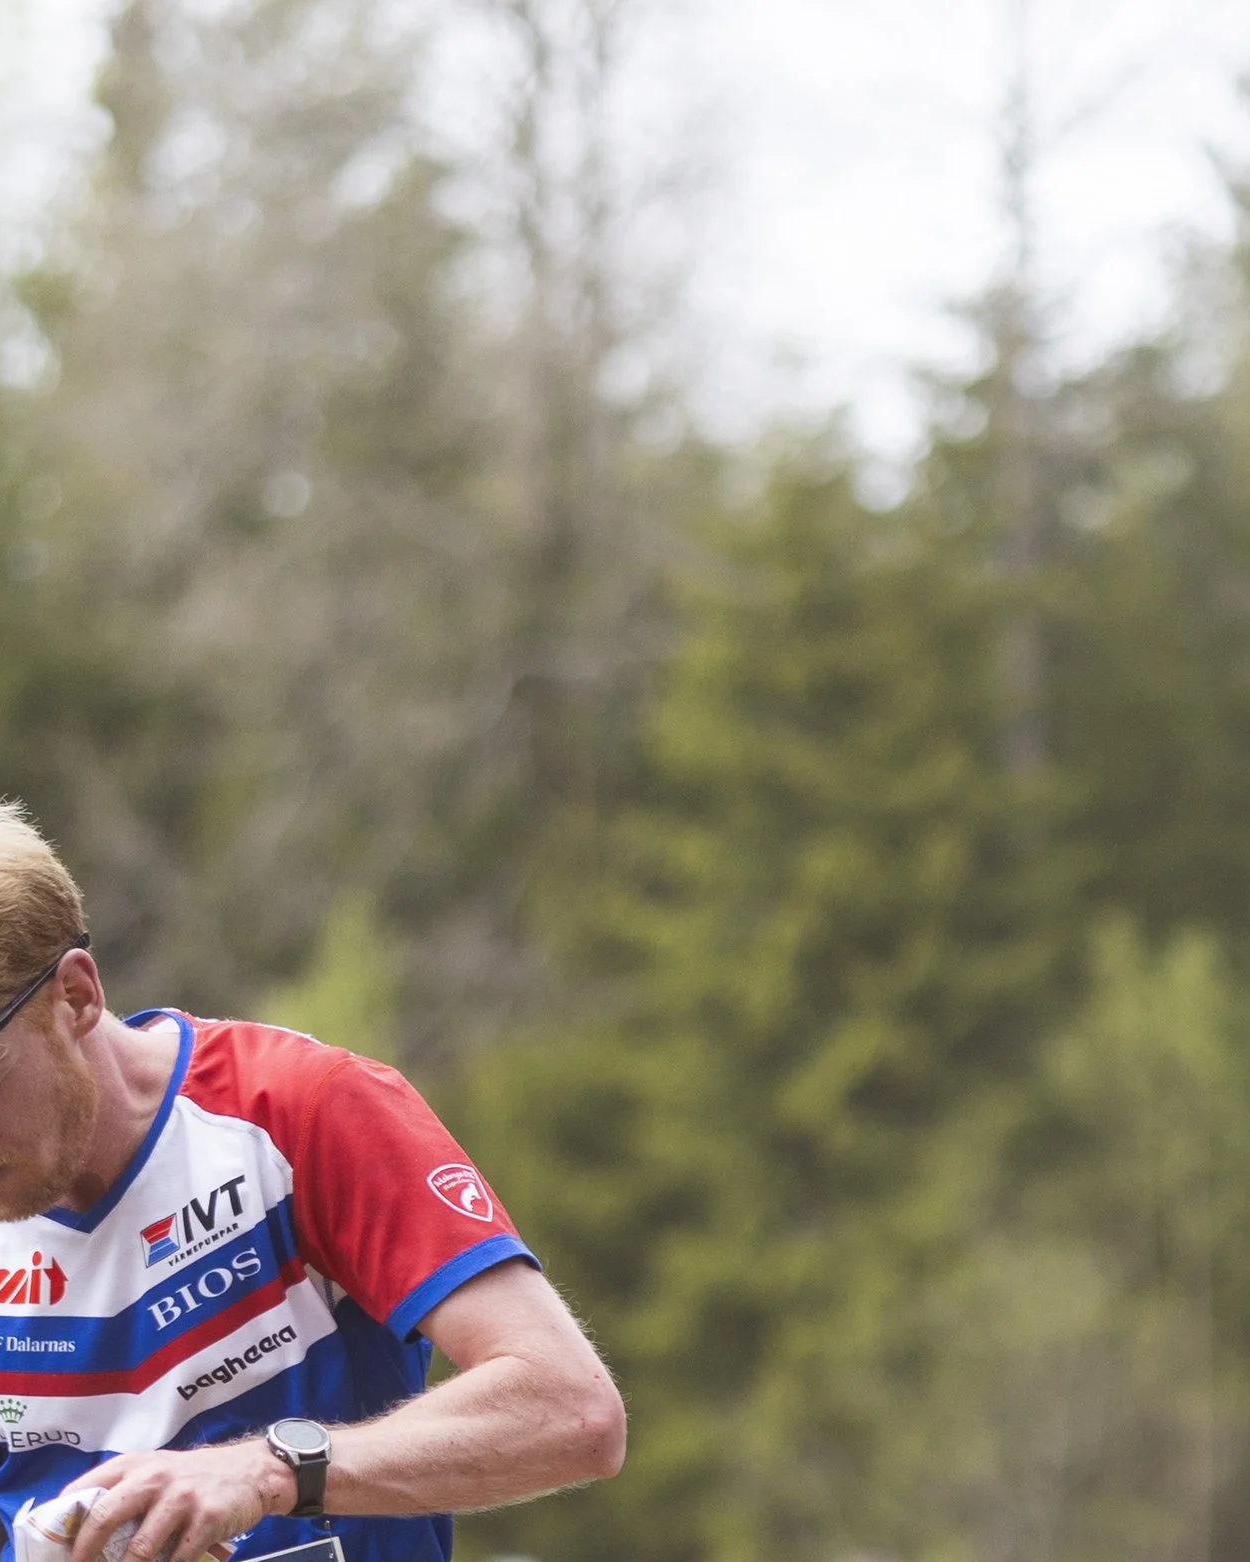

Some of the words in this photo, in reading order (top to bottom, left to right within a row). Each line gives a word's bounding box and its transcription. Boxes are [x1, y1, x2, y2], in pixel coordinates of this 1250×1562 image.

[182, 1174, 246, 1244] IVT
[147, 1247, 262, 1332] BIOS
[6, 1336, 77, 1352] Dalarnas
[176, 1324, 298, 1401] bagheera
